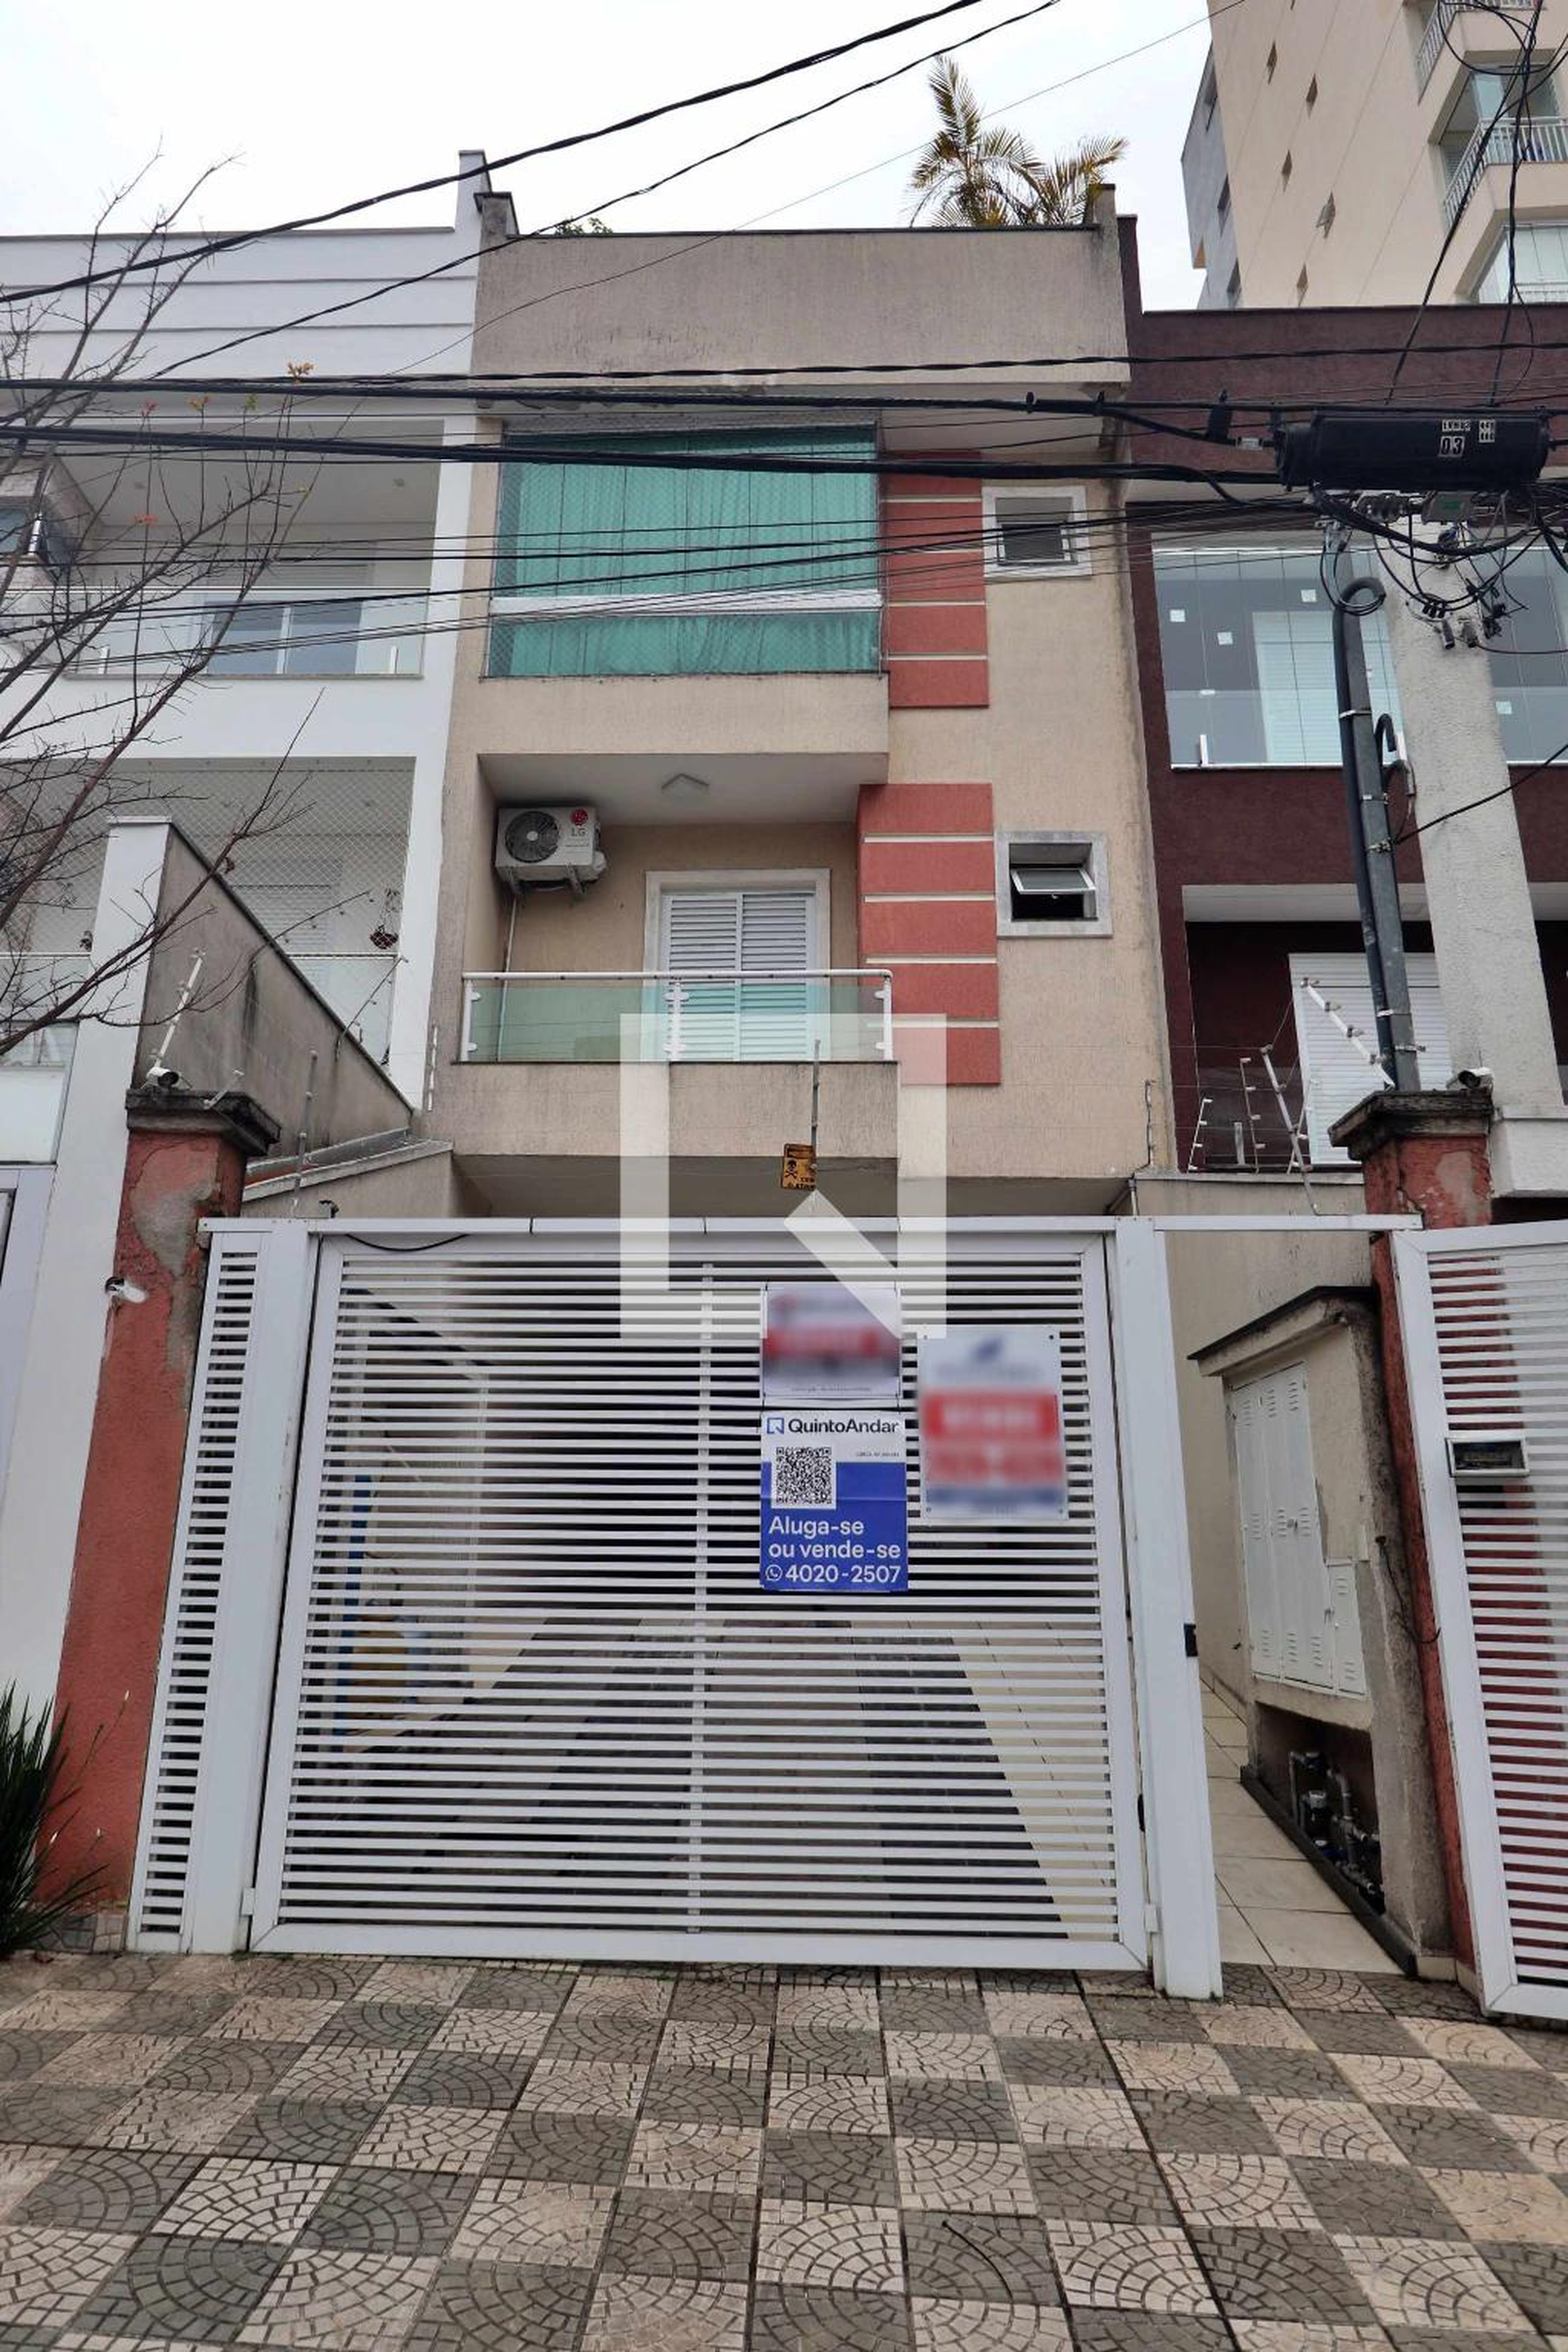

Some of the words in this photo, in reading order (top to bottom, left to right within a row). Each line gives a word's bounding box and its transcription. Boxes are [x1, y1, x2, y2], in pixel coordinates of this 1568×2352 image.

[1440, 437, 1463, 455] 03
[572, 827, 586, 837] LG
[788, 1419, 898, 1433] QuintoAndar
[768, 1516, 864, 1539] Aluga-se
[768, 1544, 794, 1558] ou
[799, 1540, 901, 1558] vende-se
